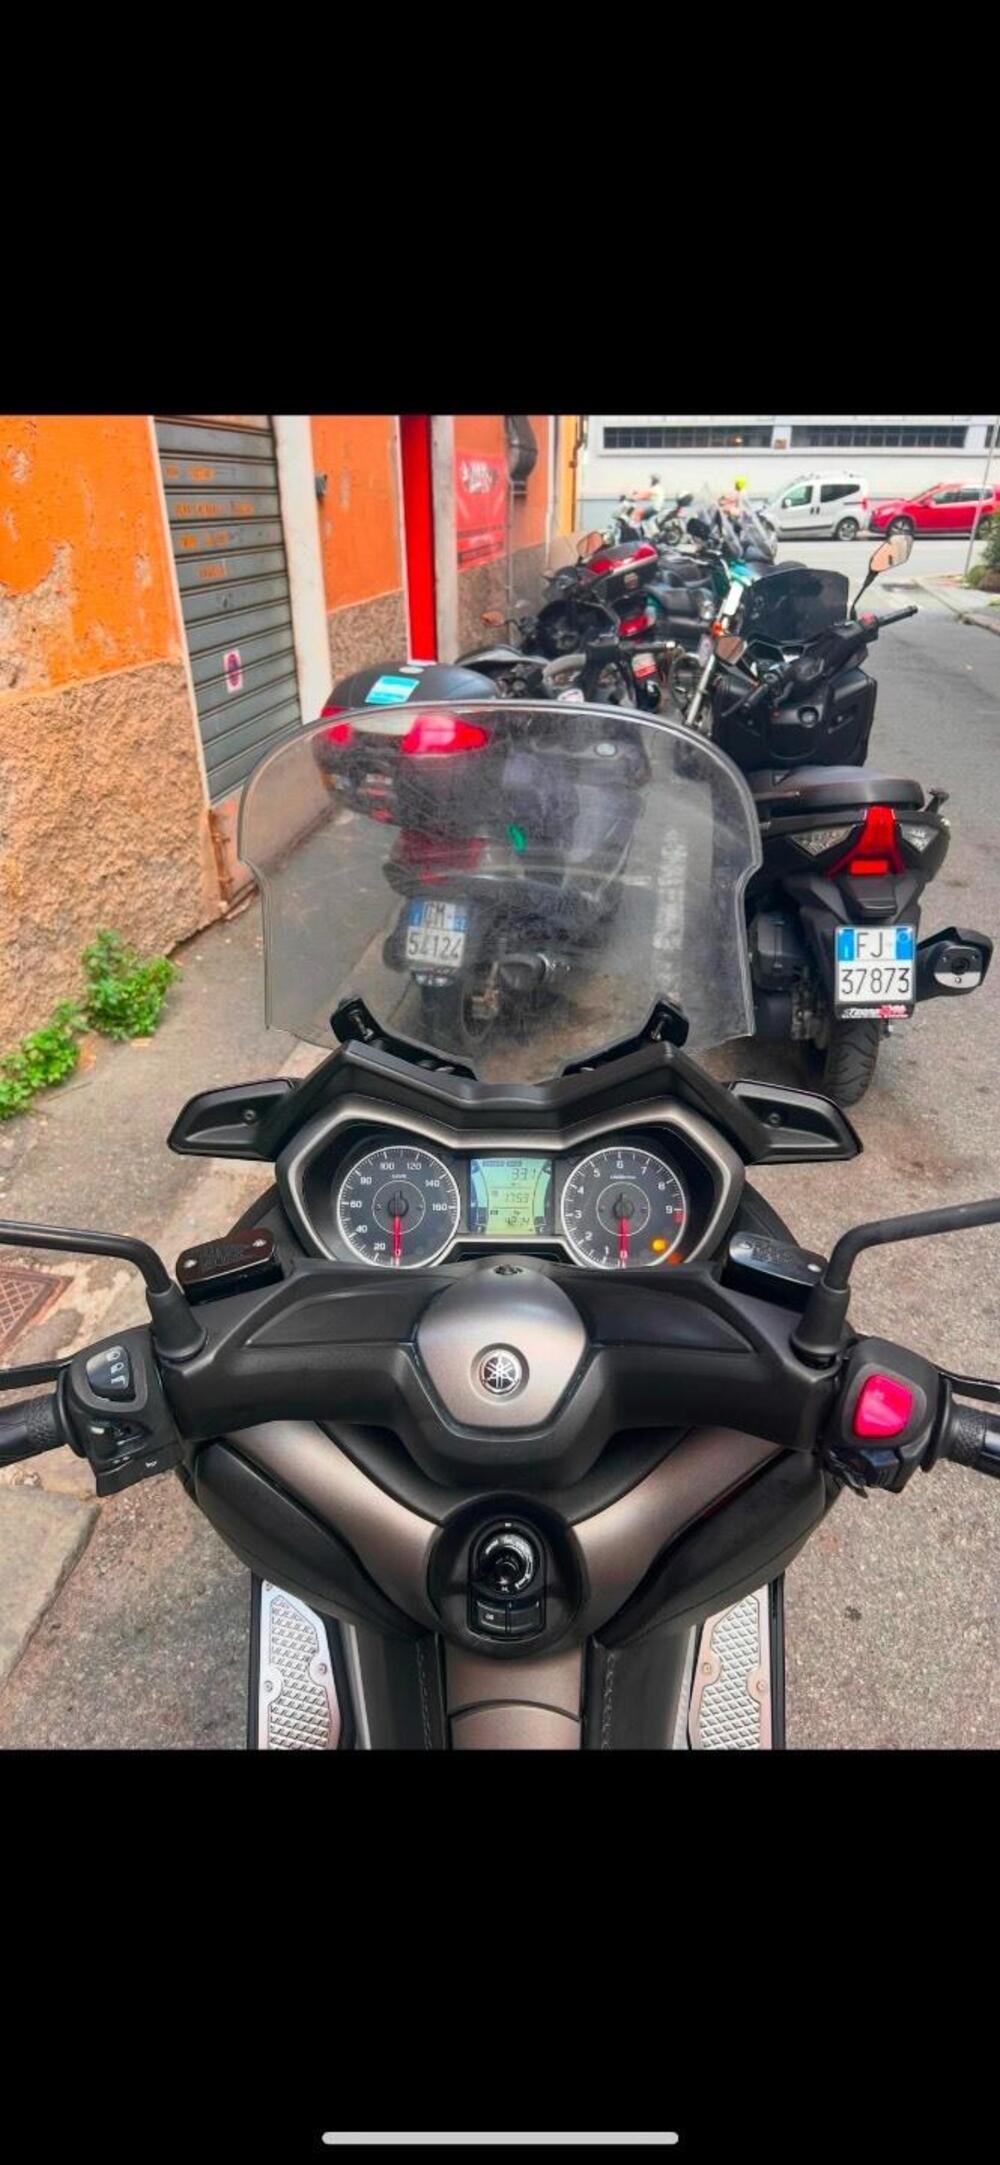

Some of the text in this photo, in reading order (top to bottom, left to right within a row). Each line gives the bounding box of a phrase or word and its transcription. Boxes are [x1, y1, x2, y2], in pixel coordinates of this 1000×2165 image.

[856, 931, 883, 958] FJ
[841, 967, 910, 995] 37873
[380, 1162, 395, 1170] 100
[407, 1162, 421, 1170] 120
[616, 1160, 624, 1169] 6
[594, 1168, 600, 1178] 5
[641, 1166, 647, 1175] 7
[360, 1177, 372, 1185] 80
[577, 1186, 584, 1195] 4
[658, 1181, 665, 1191] 8
[350, 1200, 362, 1208] 60
[432, 1203, 447, 1211] 160
[665, 1205, 673, 1214] 9
[575, 1210, 582, 1219] 3
[356, 1225, 368, 1233] 40
[585, 1231, 593, 1240] 2
[605, 1245, 609, 1255] 1
[620, 1250, 628, 1259] 0
